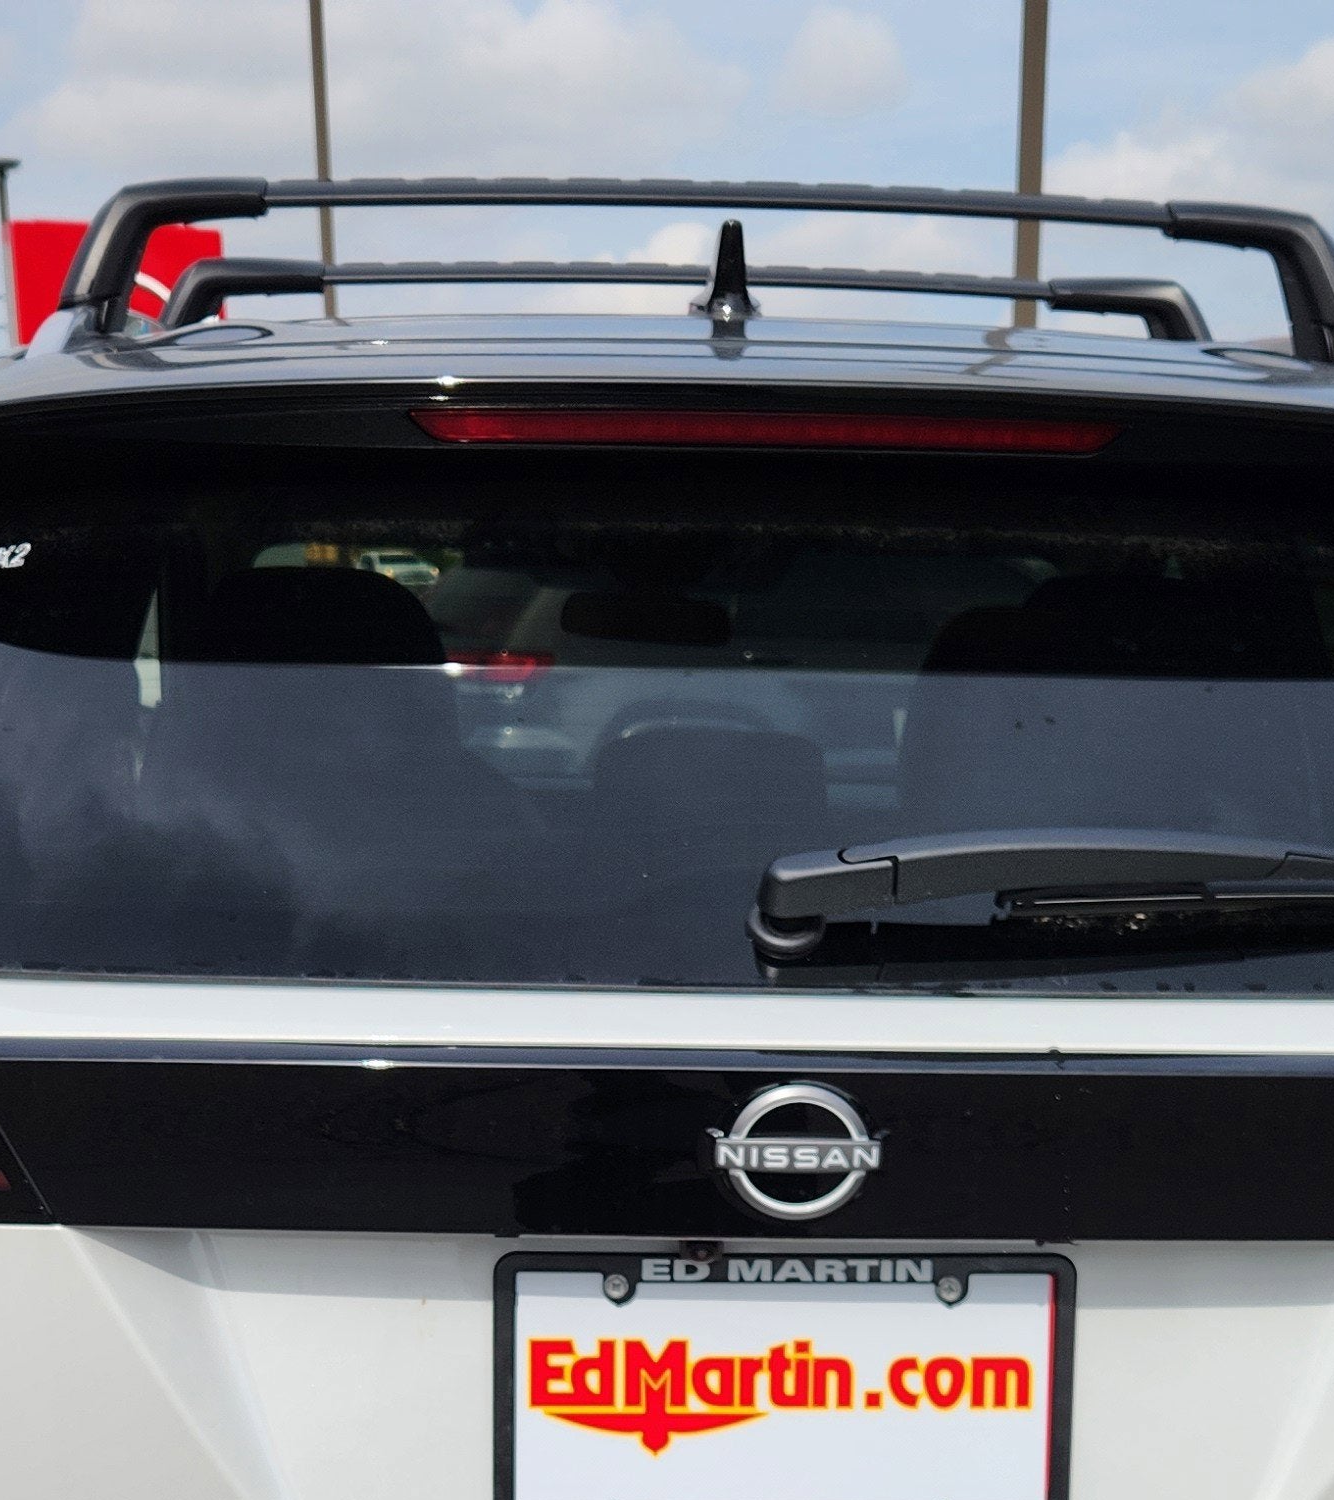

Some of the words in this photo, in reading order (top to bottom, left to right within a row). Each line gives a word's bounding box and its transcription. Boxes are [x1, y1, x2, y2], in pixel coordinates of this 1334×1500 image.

[716, 1144, 879, 1169] NISSAN
[640, 1258, 709, 1282] ED
[727, 1258, 934, 1283] MARTIN
[528, 1338, 1033, 1410] EdMartin.com
